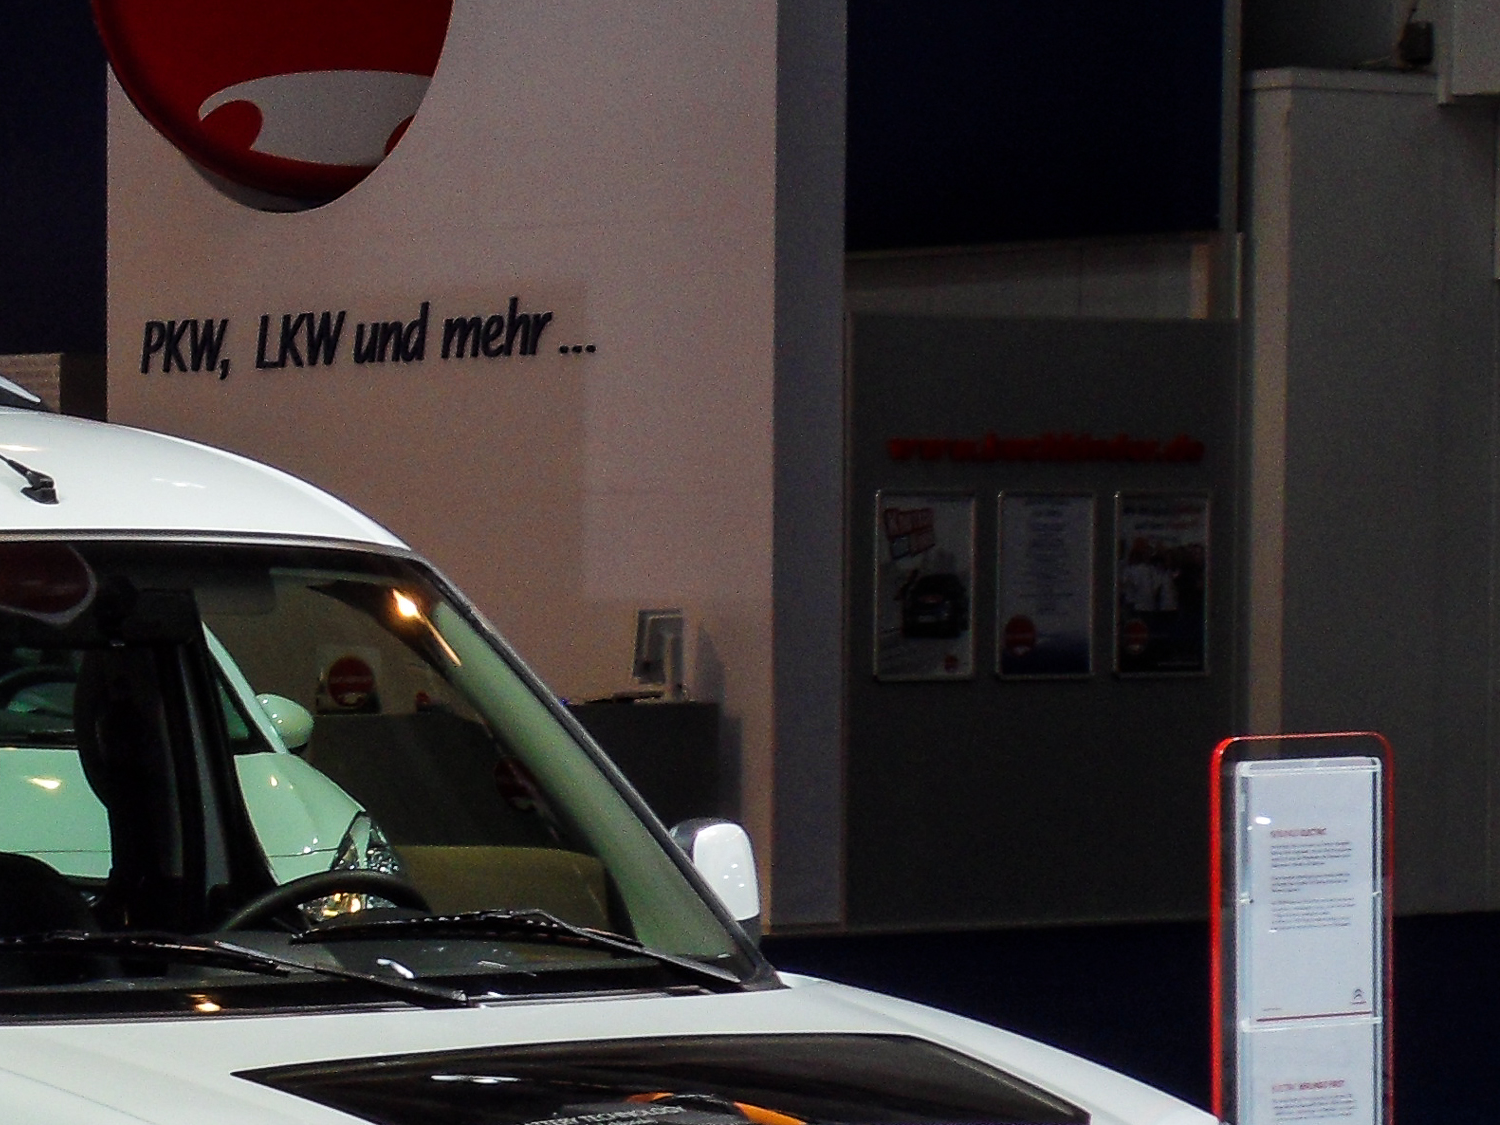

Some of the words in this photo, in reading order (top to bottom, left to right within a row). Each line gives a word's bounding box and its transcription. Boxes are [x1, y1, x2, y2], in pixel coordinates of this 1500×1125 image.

[140, 318, 229, 380] PKW,
[255, 310, 346, 369] LKW
[353, 301, 430, 364] und
